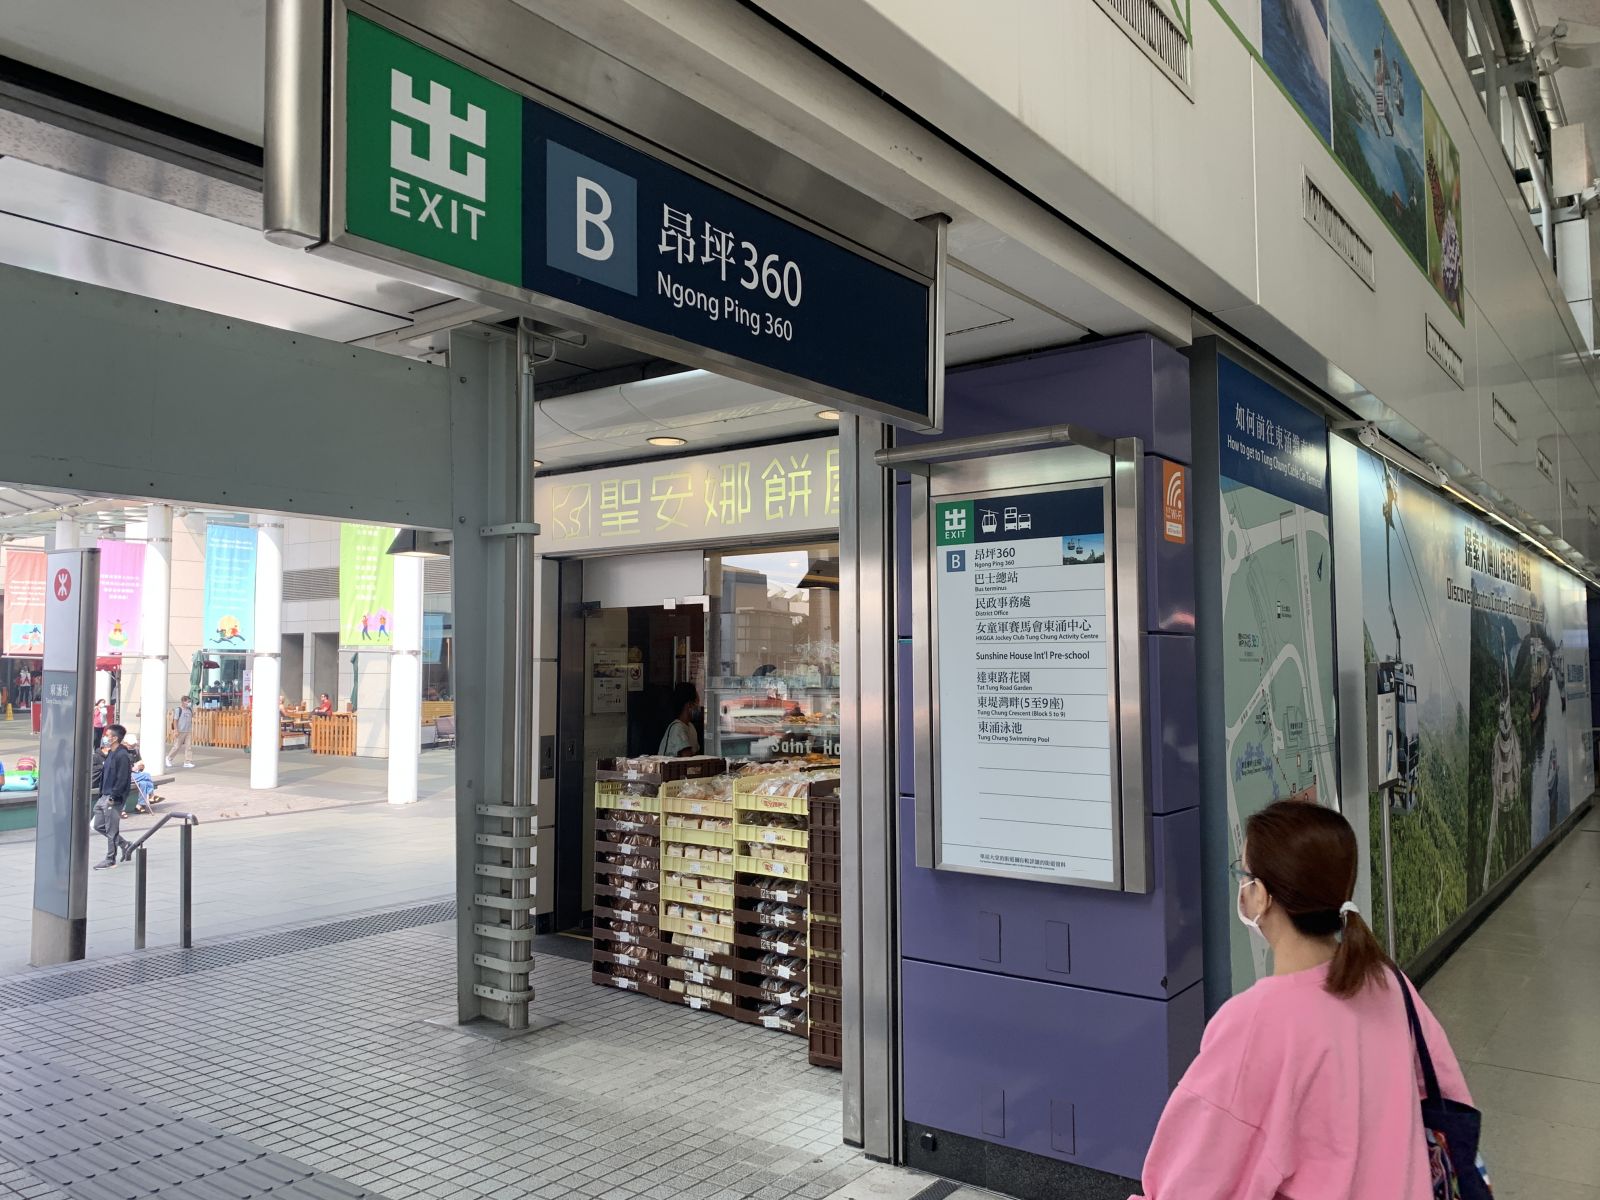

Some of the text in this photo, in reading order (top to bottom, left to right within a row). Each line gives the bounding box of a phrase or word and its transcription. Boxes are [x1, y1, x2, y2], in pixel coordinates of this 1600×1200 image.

[389, 176, 486, 241] EXIT
[576, 176, 615, 261] B
[658, 203, 802, 307] 昂坪360
[657, 270, 793, 341] Ngong Ping 360
[1227, 434, 1239, 452] How
[1240, 441, 1246, 455] to
[1246, 445, 1255, 461] get
[1255, 447, 1261, 462] to
[1260, 450, 1273, 470] Tung
[1273, 456, 1287, 477] Chung
[945, 530, 966, 539] EXIT
[975, 548, 1016, 560] 昂坪360
[952, 554, 960, 569] B
[975, 571, 1018, 584] 巴士總站
[976, 596, 1031, 609] 民政事務處
[976, 619, 1091, 634] 女童軍賽馬會東涌中心
[1040, 633, 1058, 641] Chung
[1059, 633, 1079, 641] Activity
[976, 650, 1090, 660] Sunshine House Int'l Pre-school
[977, 671, 1030, 683] 達東路花園
[978, 721, 1023, 734] 東涌泳池
[991, 734, 1009, 742] Chung
[1009, 735, 1037, 743] Swimming
[771, 738, 812, 754] Saint
